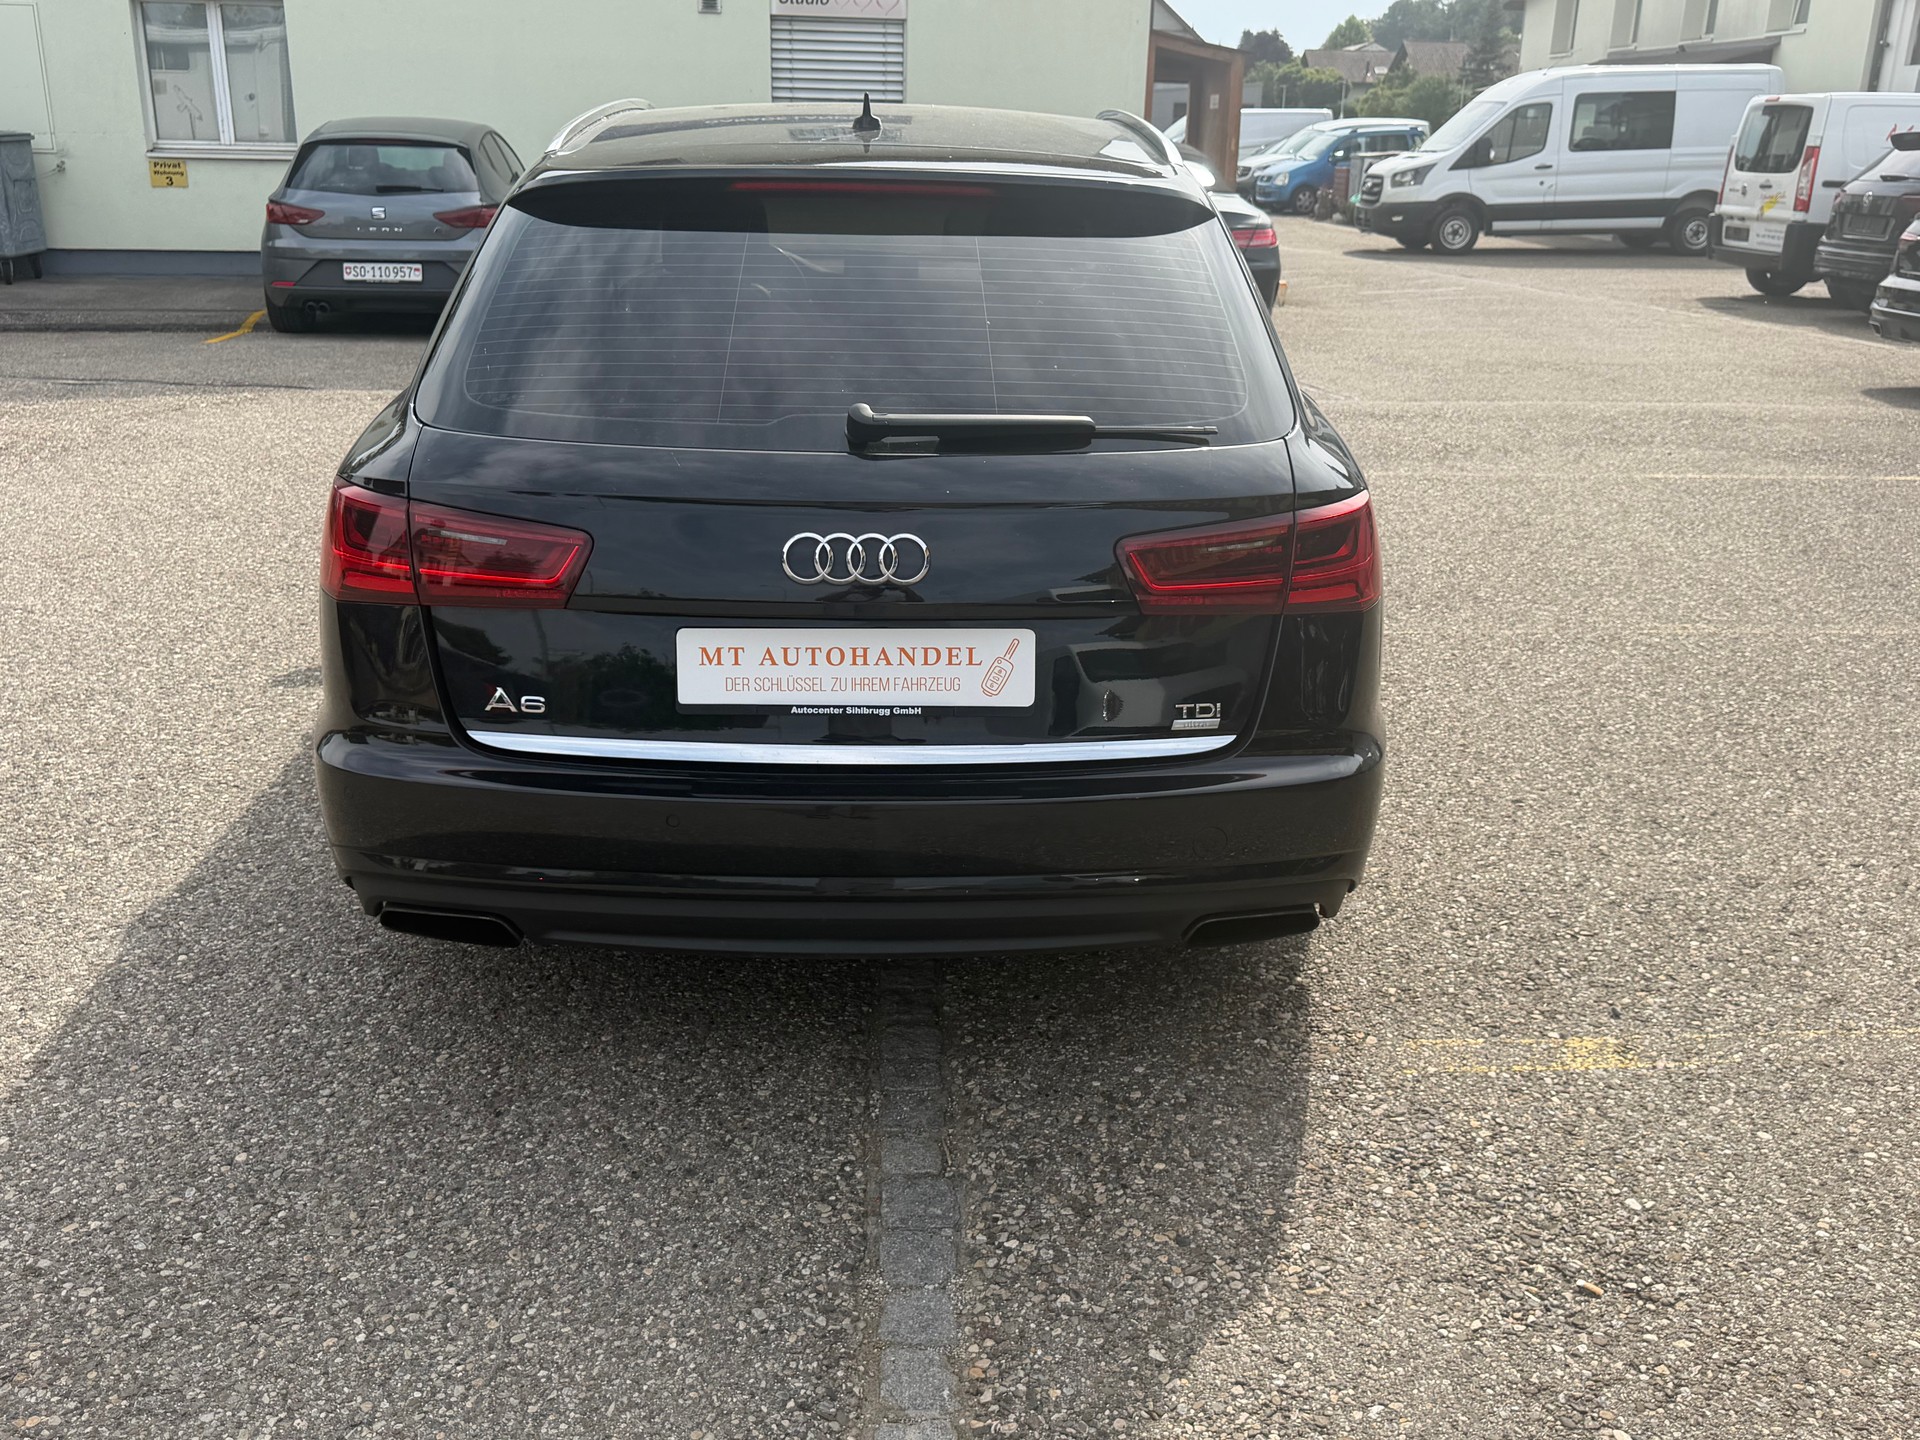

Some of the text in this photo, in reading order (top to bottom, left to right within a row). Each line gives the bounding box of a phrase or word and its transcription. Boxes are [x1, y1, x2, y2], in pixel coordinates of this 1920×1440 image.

[153, 161, 181, 169] Privat
[166, 176, 174, 186] 3
[699, 646, 984, 667] MT AUTOHANDEL
[725, 674, 961, 692] DER SCHLÜSSEL ZU IHREM FAHRZEUG
[484, 686, 546, 713] A6
[791, 706, 922, 716] Autocenter Sihlbrugg GmbH
[1175, 702, 1221, 718] TDI
